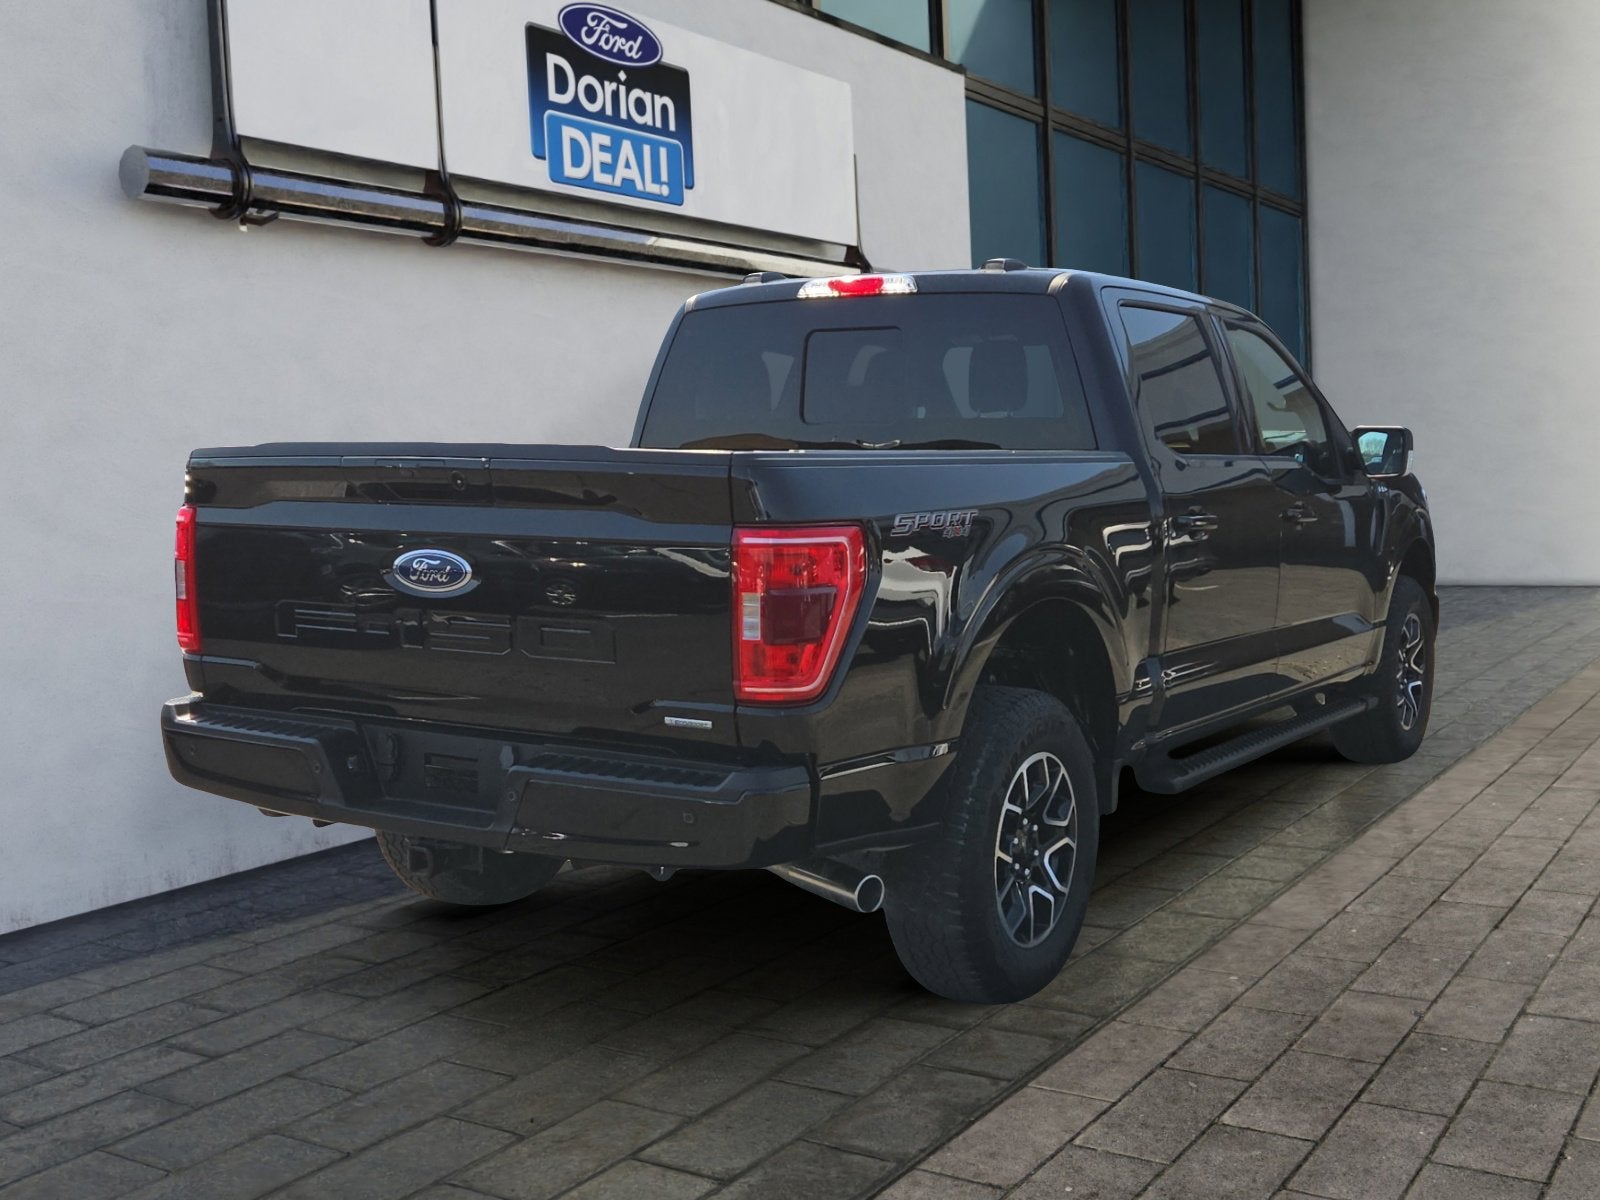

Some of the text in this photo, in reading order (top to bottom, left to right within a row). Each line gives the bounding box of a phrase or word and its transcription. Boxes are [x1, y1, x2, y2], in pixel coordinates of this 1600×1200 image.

[580, 12, 643, 59] Ford
[546, 52, 676, 132] Dorian
[561, 125, 670, 197] DEAL!
[890, 509, 978, 537] SPORT
[409, 558, 451, 582] Ford
